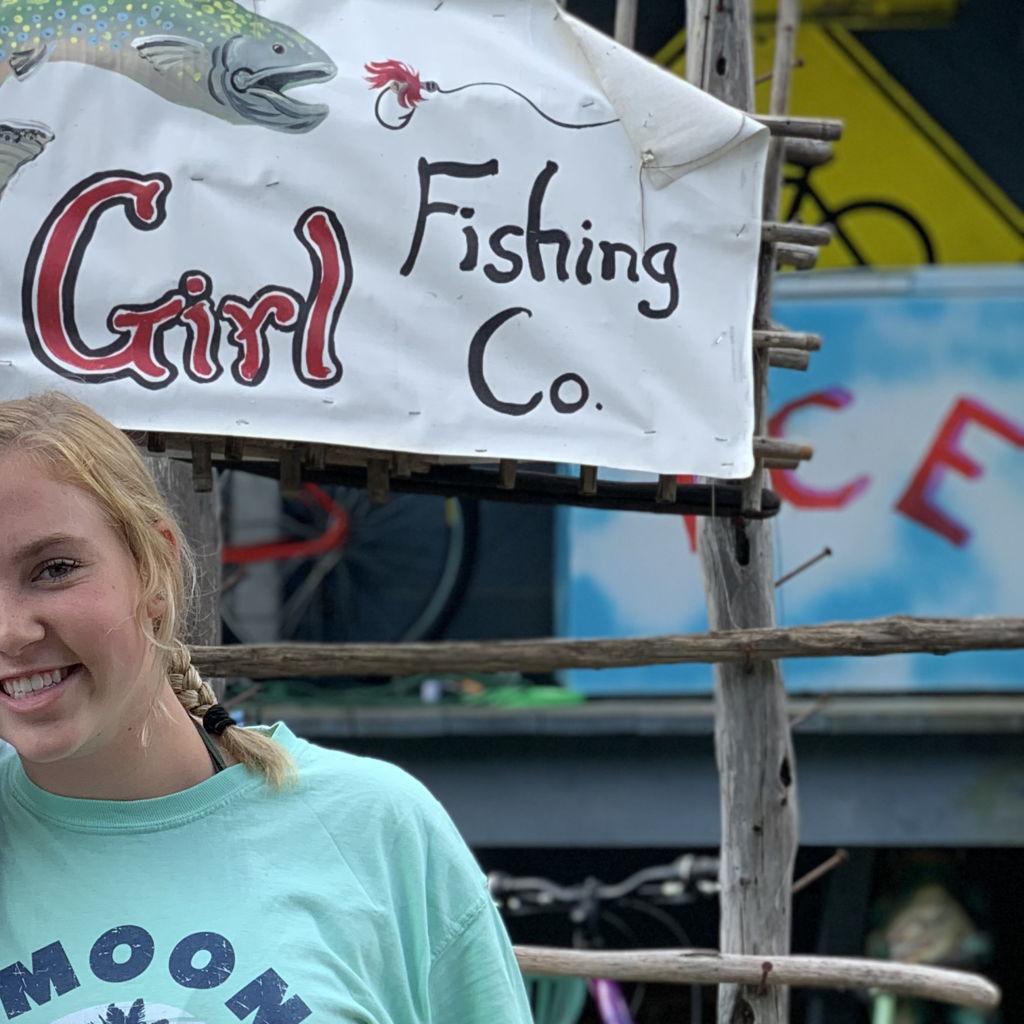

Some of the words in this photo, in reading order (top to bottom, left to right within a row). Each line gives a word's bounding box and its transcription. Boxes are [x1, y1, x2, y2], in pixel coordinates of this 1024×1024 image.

[22, 170, 352, 389] Girl
[400, 157, 678, 319] Fishing
[469, 306, 603, 417] Co.
[676, 384, 1024, 554] CE
